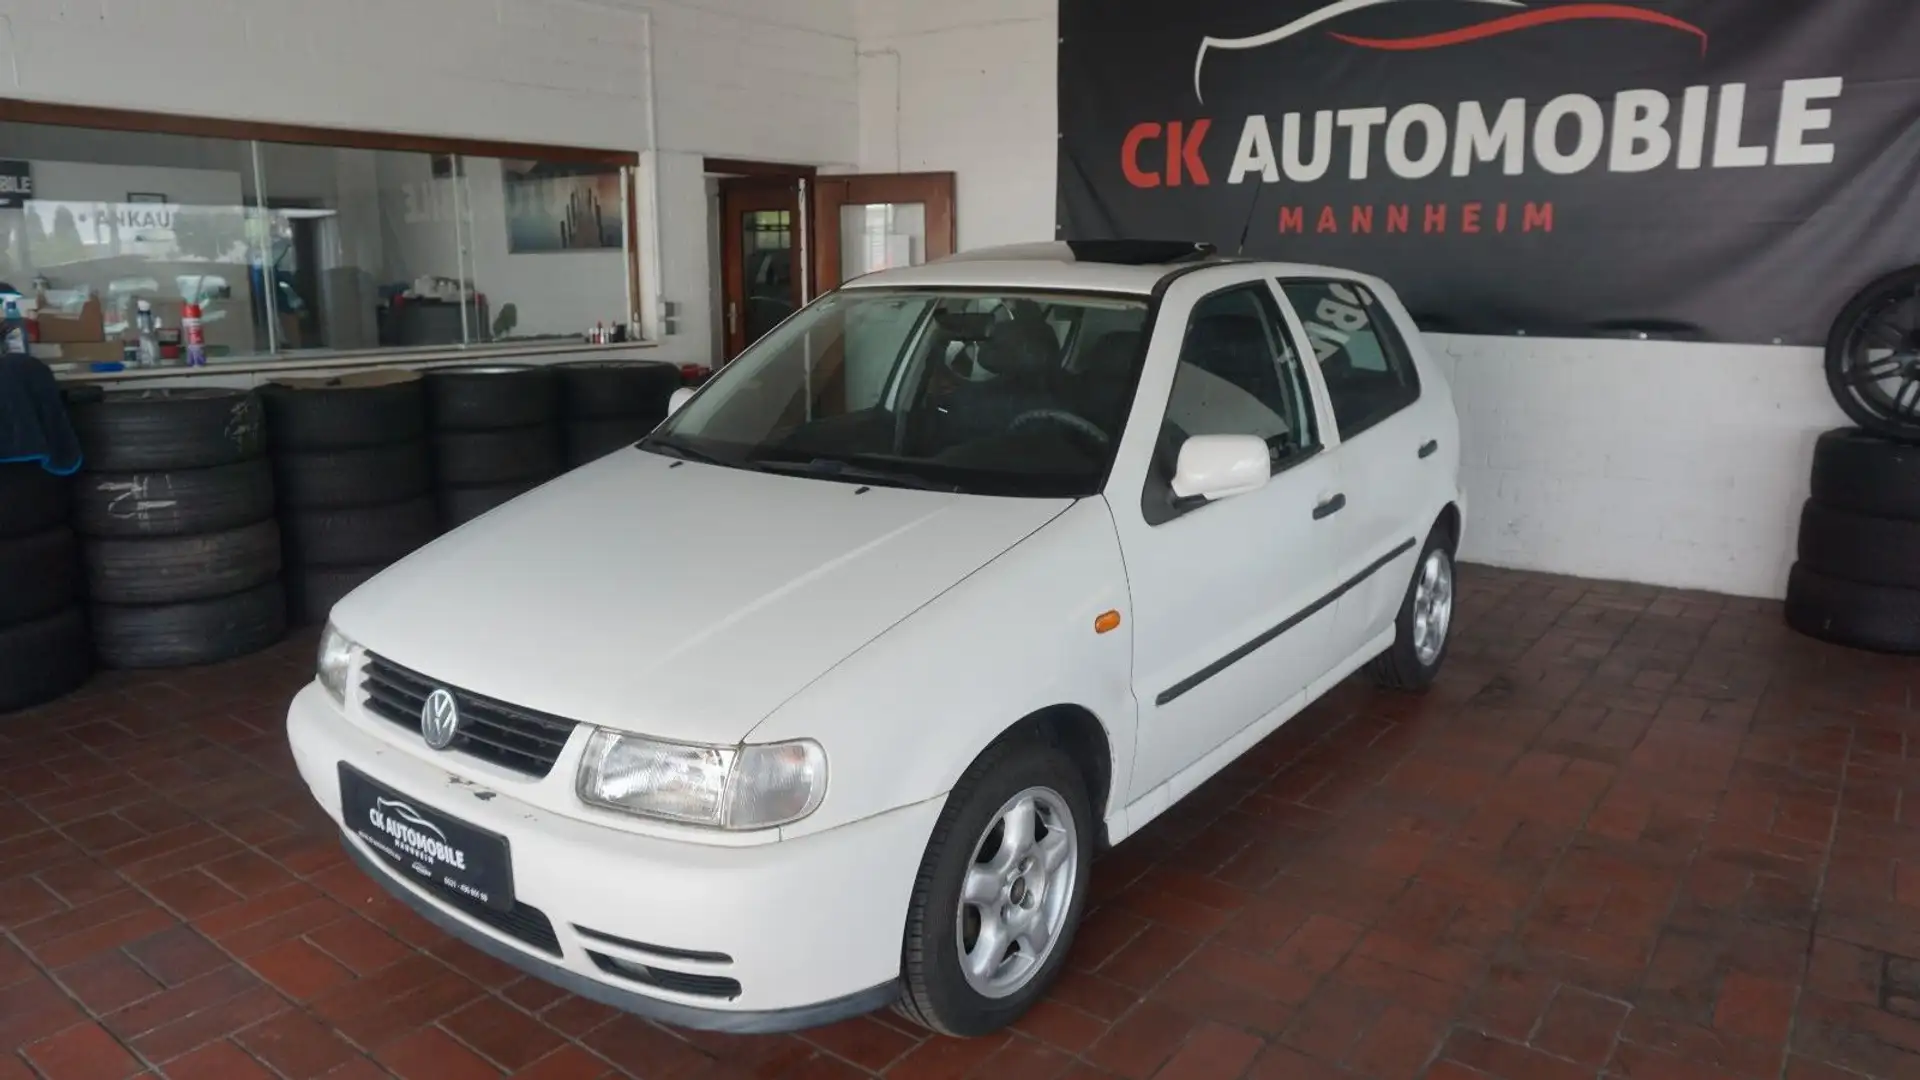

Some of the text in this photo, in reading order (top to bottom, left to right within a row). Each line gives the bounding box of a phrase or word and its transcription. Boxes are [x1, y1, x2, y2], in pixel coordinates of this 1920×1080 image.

[1121, 76, 1843, 188] CK AUTOMOBILE
[1279, 202, 1553, 233] MANNHEIM
[369, 807, 385, 831] CK
[386, 817, 466, 870] AUTOMOBILE
